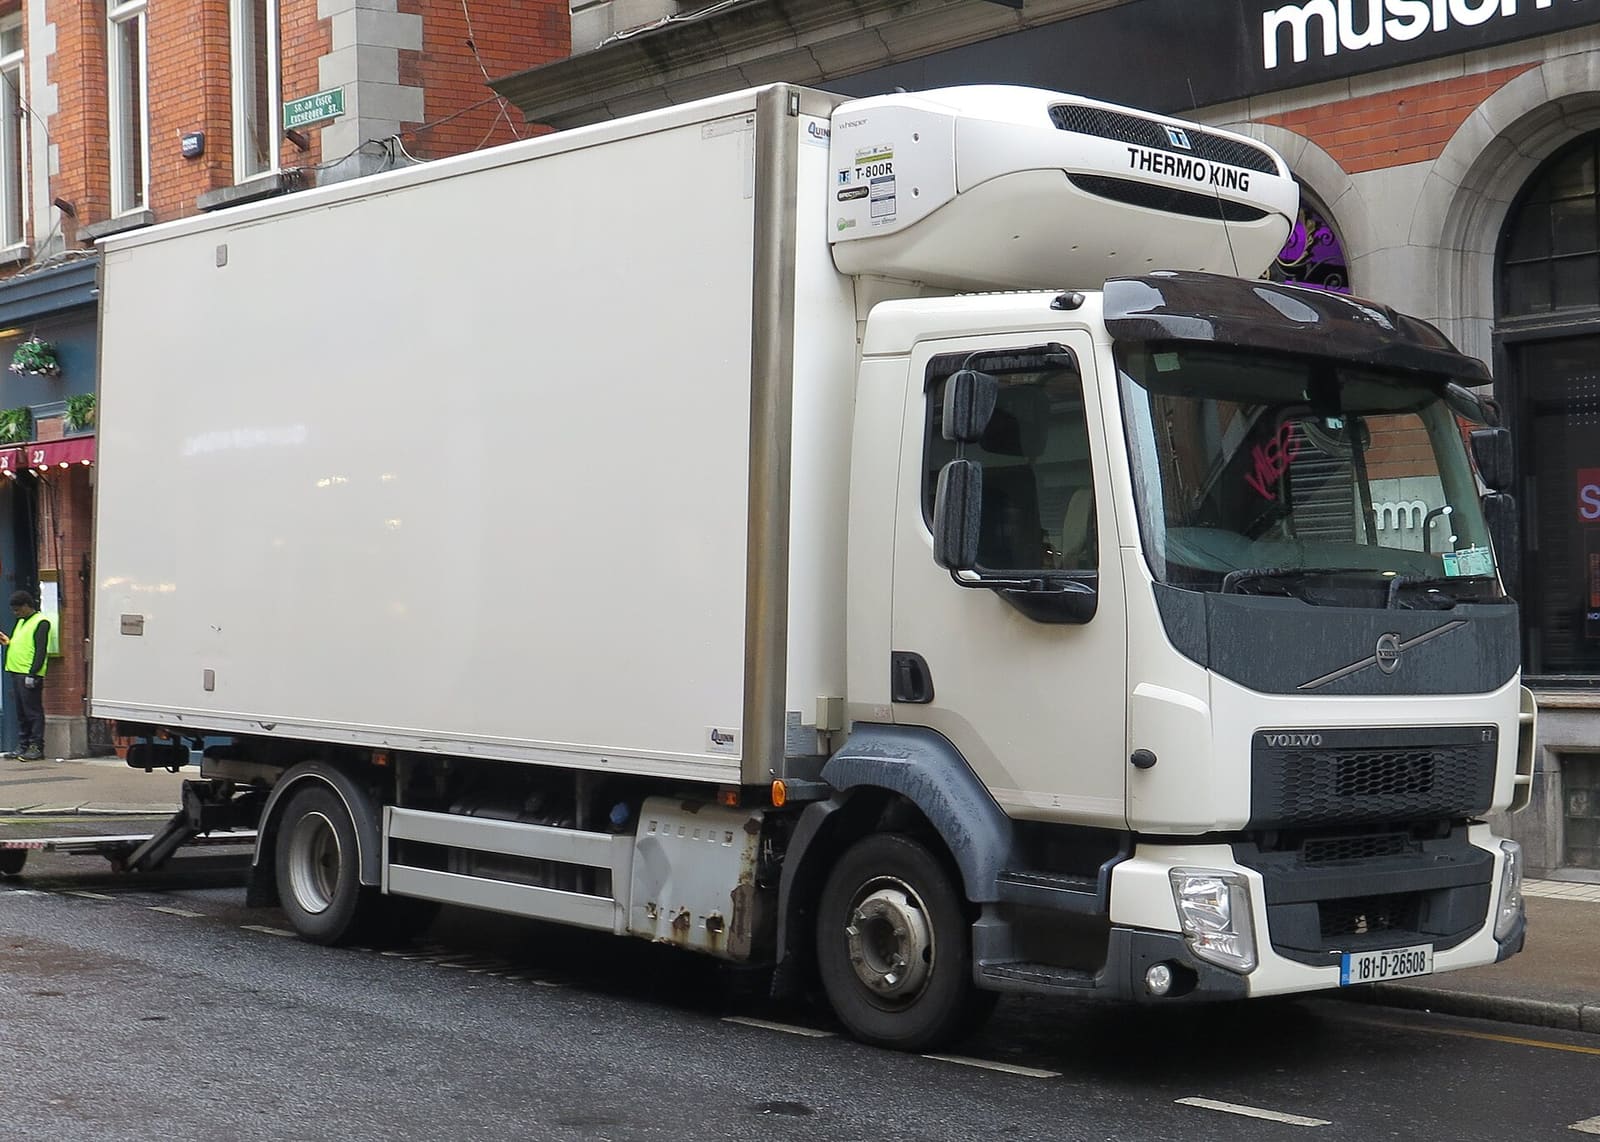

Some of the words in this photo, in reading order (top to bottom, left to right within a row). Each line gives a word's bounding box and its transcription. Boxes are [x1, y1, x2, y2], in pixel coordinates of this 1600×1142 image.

[855, 162, 893, 180] T-800R
[1127, 147, 1206, 182] THERMO
[1208, 164, 1250, 193] KING
[33, 450, 45, 463] 27
[1264, 734, 1323, 747] VOLVO
[1358, 951, 1426, 980] 181-D-26508
